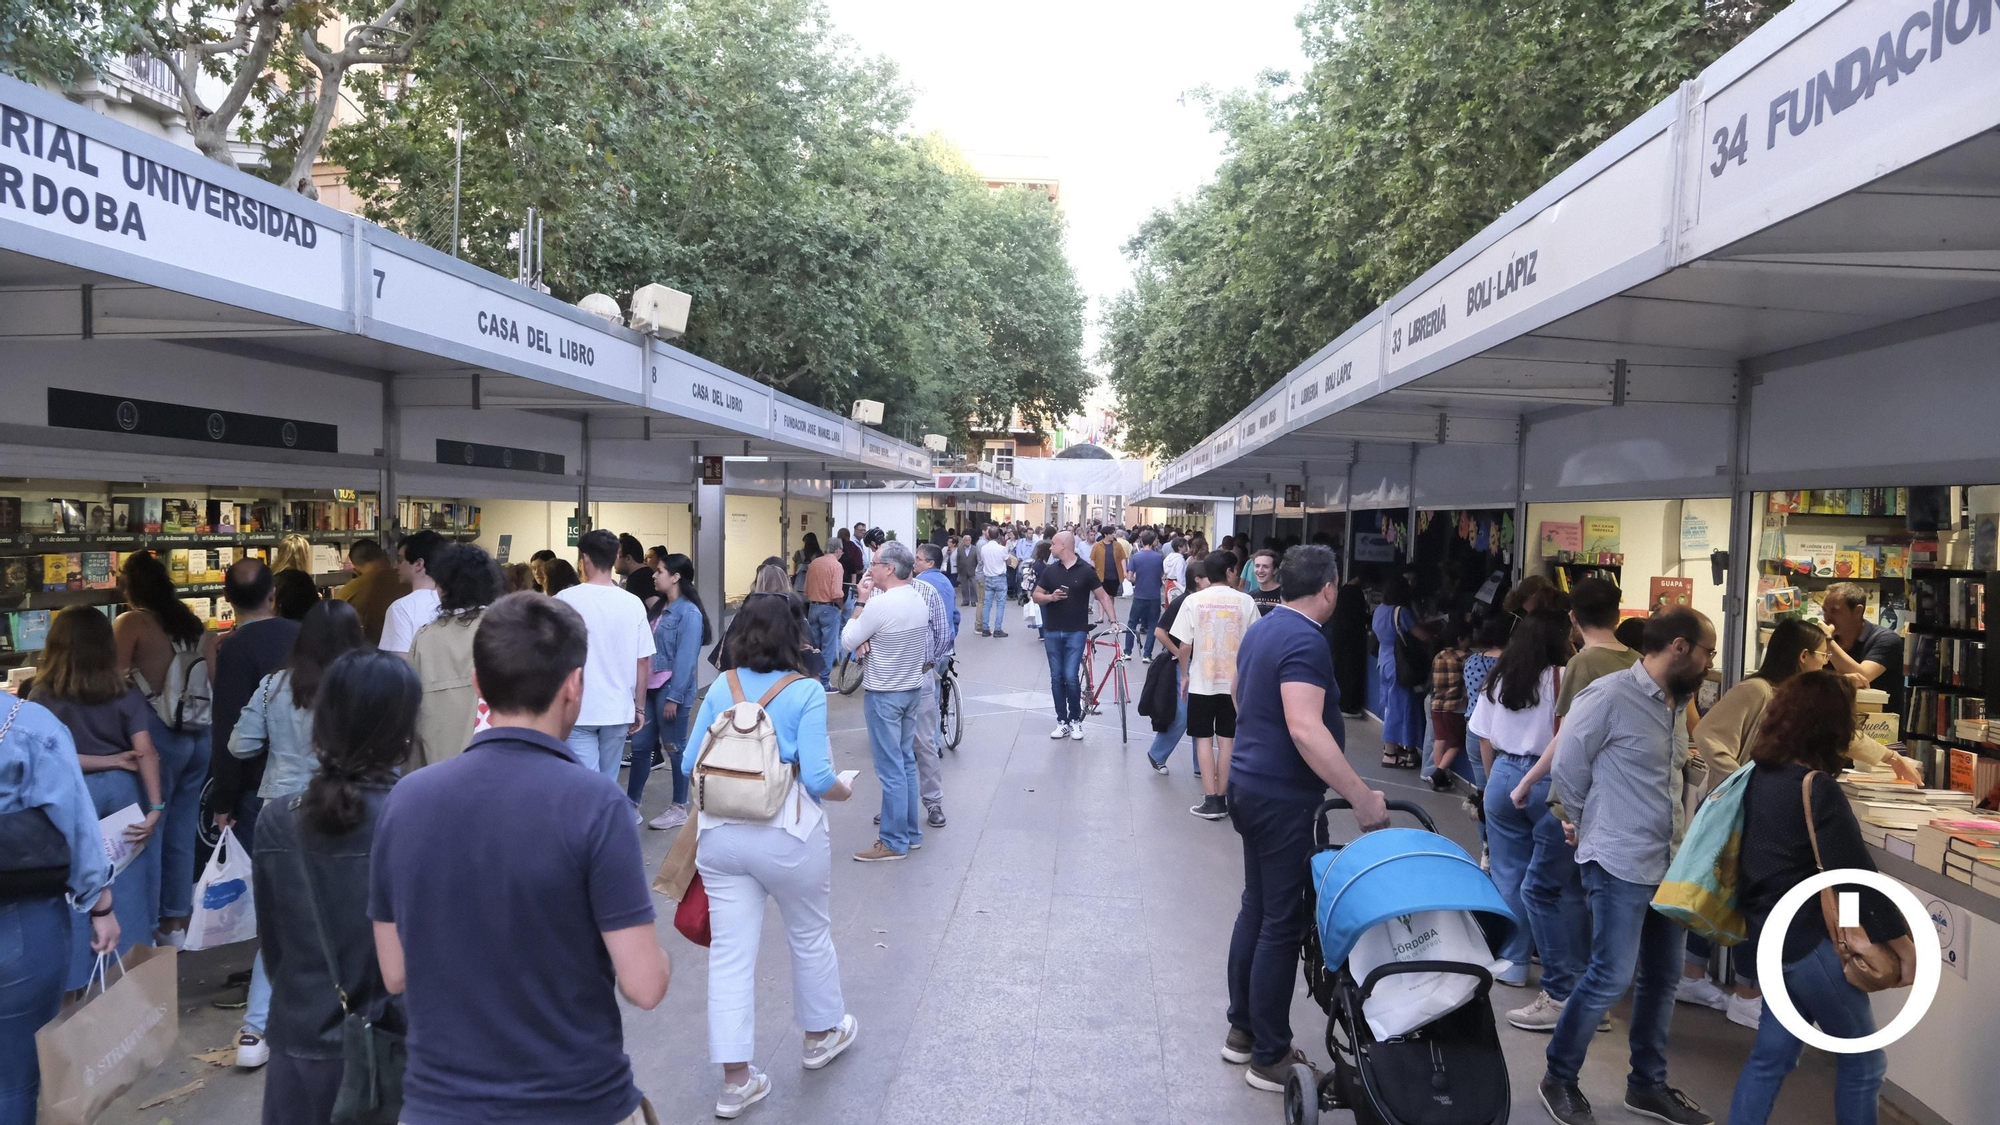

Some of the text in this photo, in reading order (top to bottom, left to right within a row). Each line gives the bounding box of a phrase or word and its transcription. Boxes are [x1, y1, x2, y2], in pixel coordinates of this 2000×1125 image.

[1710, 113, 1748, 178] 34
[122, 150, 317, 249] UNIVERSIDAD
[373, 269, 386, 299] 7
[1392, 250, 1538, 355] 33 LIBRERÍA BOLI-LÁPIZ
[477, 311, 595, 367] CASA DEL LIBRO
[652, 366, 657, 384] 8
[692, 383, 743, 412] CASA DEL LIBRO
[1393, 928, 1438, 957] CÓRDOBA
